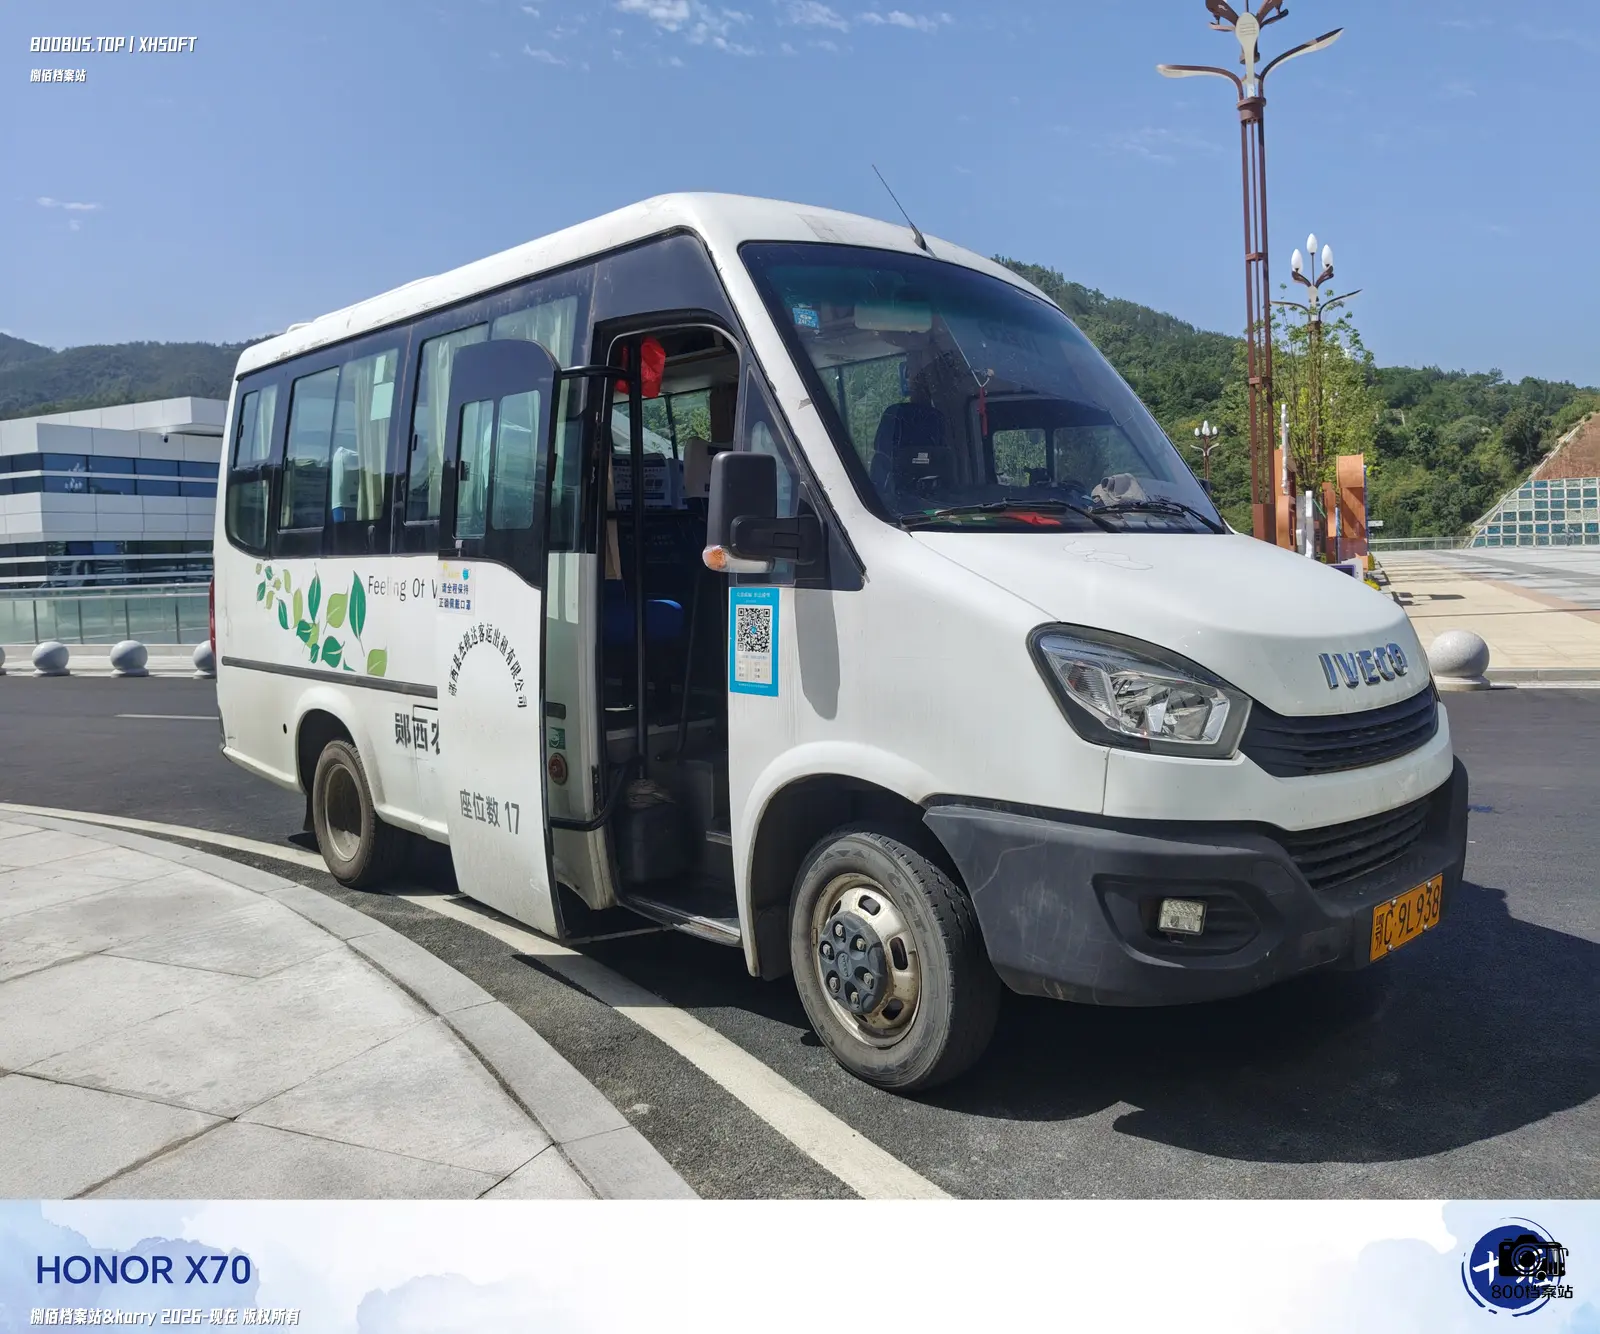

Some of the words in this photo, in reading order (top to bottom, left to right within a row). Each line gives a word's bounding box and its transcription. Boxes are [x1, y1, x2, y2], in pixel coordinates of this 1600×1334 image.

[1317, 642, 1409, 690] IVECO
[459, 788, 501, 828] 座位数
[504, 801, 520, 835] 17
